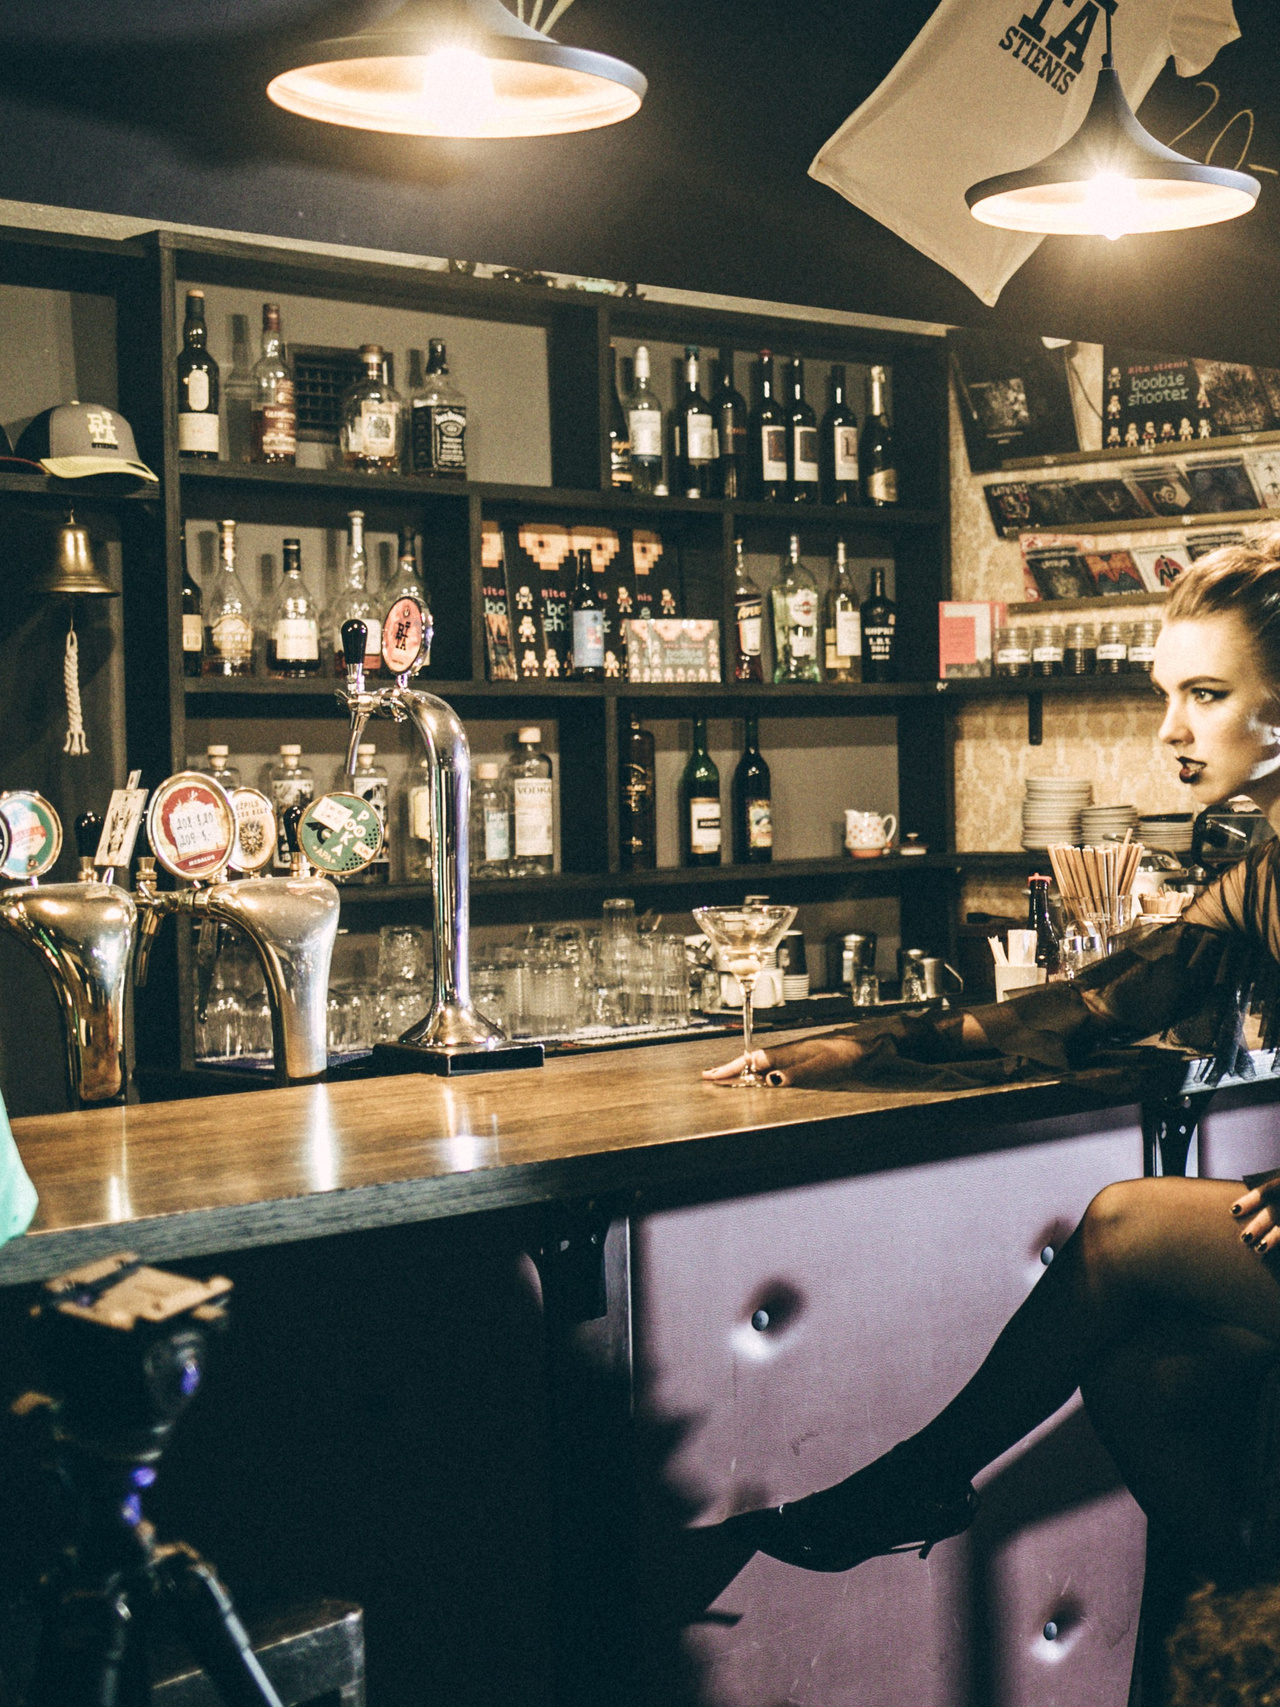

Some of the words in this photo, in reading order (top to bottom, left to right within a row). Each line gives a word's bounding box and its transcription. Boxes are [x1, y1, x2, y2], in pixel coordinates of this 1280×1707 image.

[998, 25, 1077, 95] STIENIS
[1131, 371, 1185, 391] boobie
[1127, 387, 1190, 407] shooter
